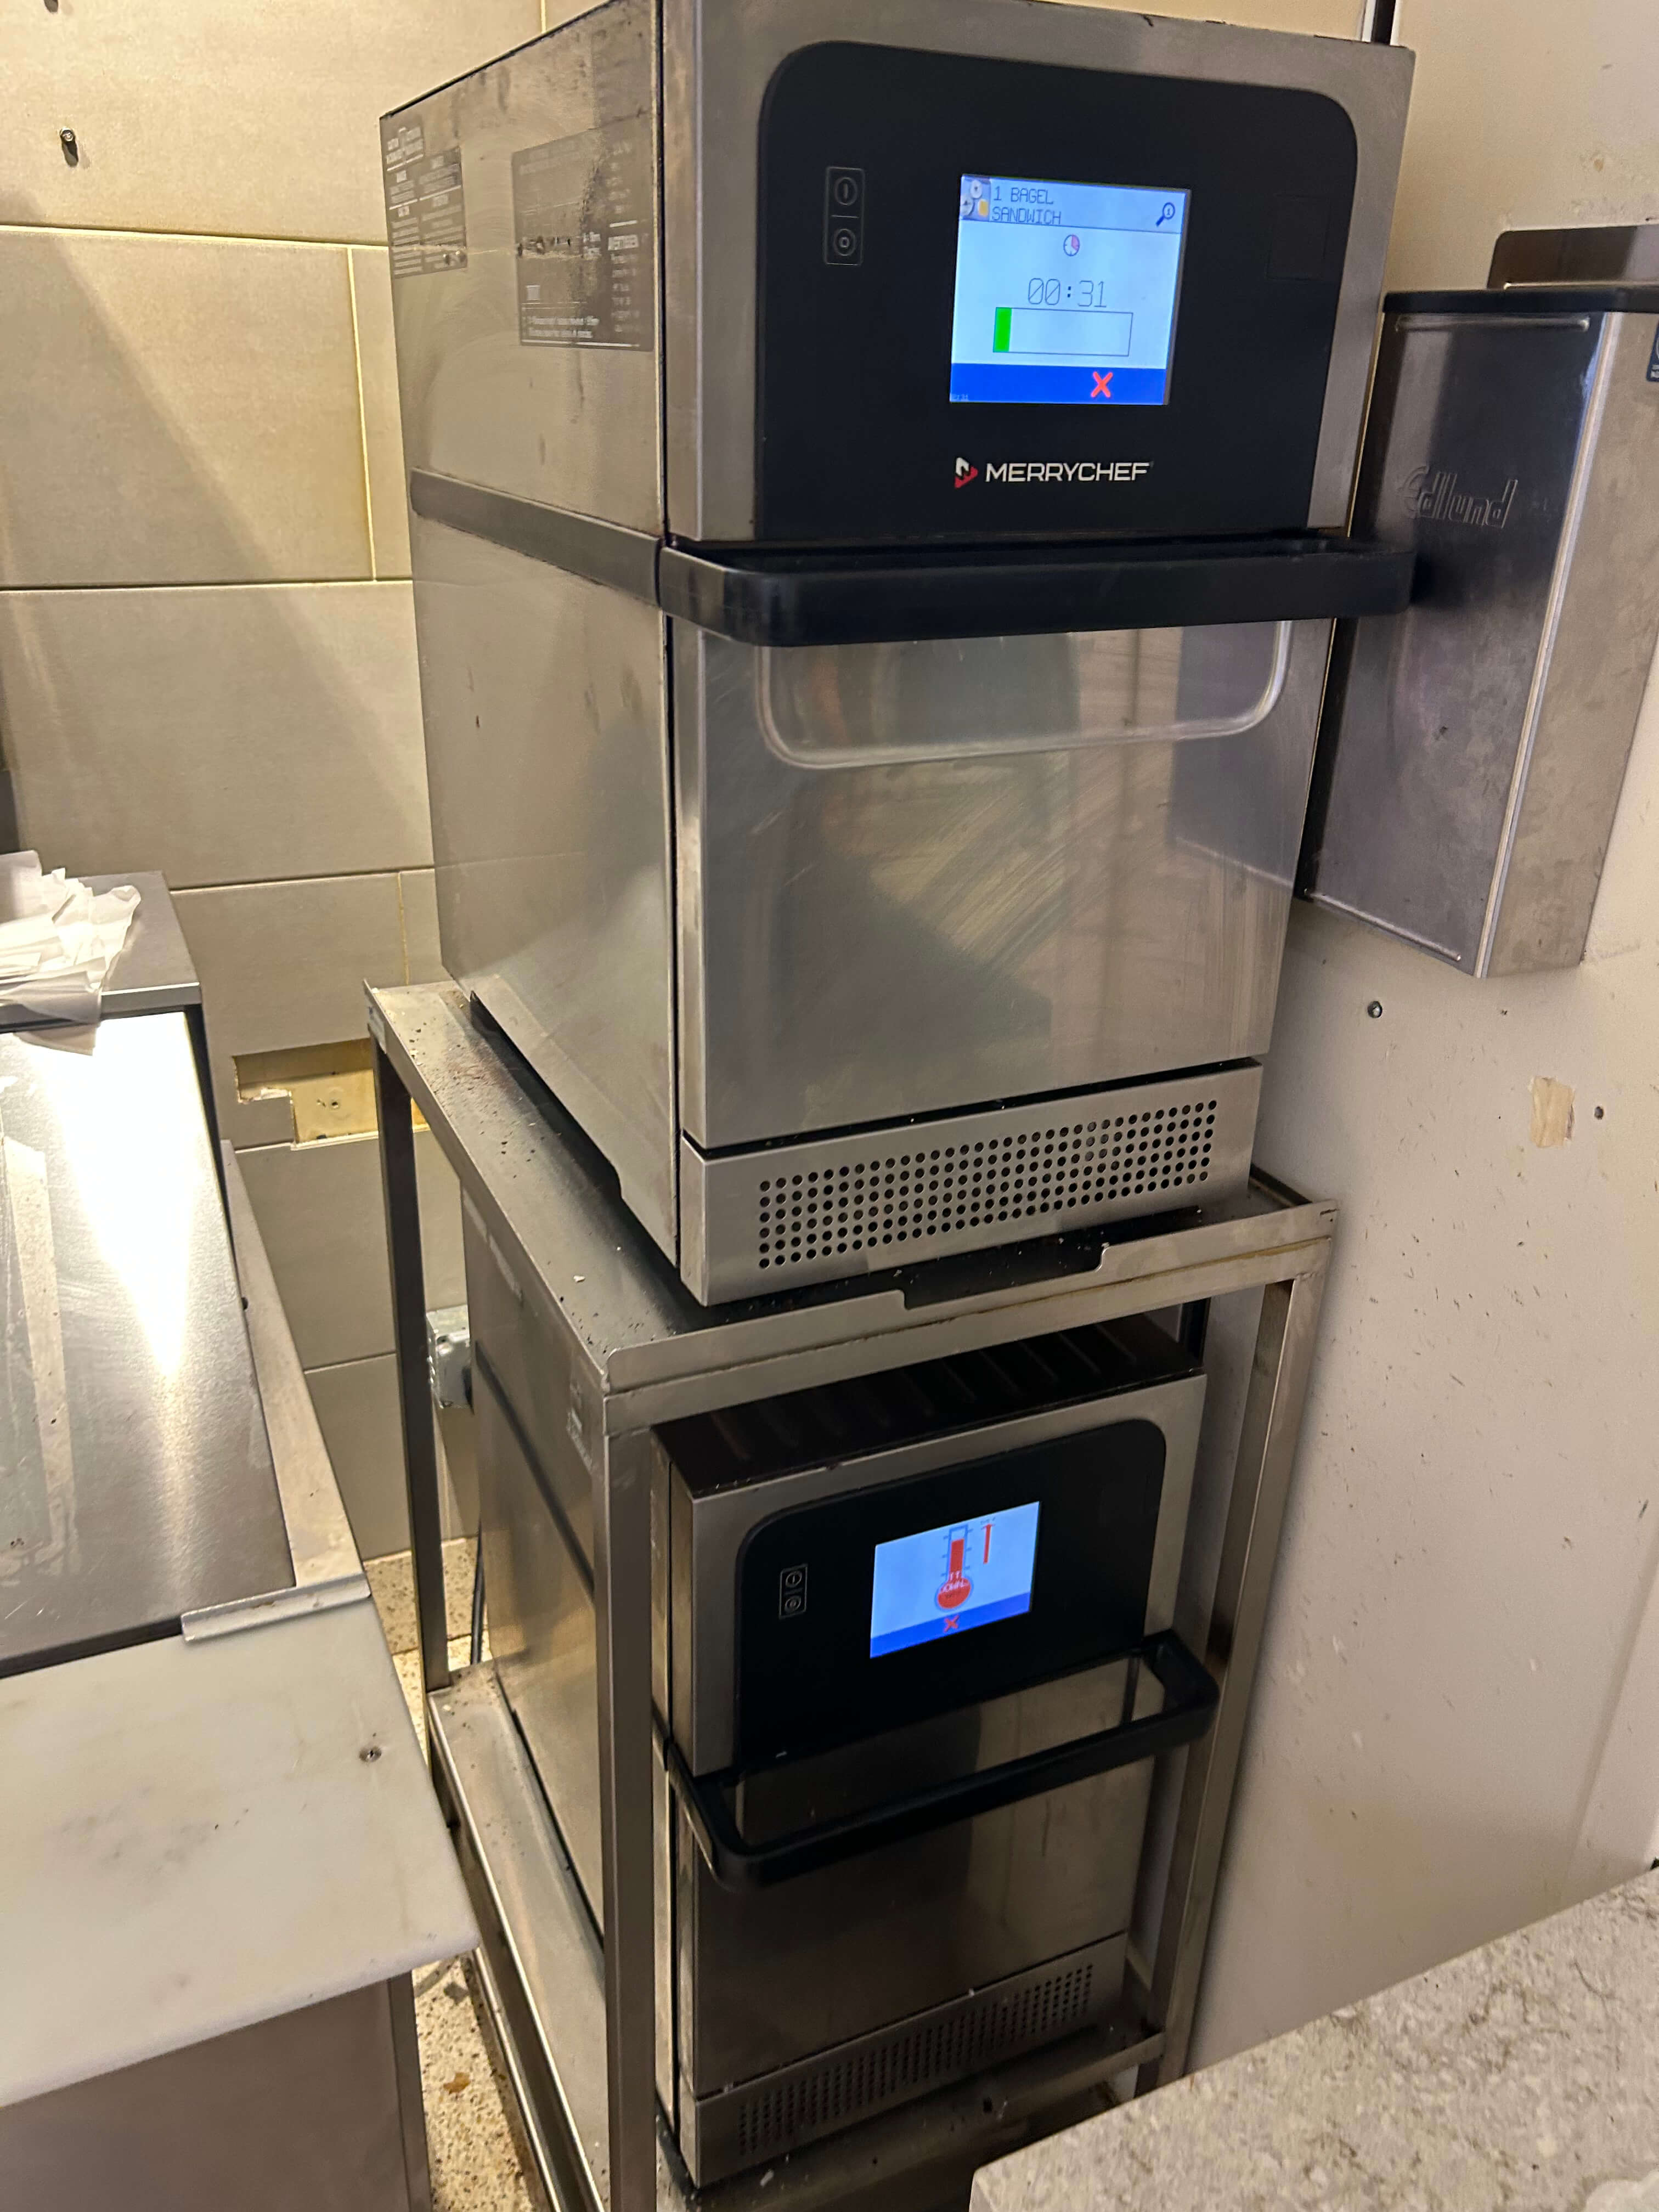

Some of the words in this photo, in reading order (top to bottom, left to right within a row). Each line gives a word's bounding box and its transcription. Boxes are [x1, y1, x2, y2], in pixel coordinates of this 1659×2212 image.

[994, 186, 1002, 201] 1
[1011, 187, 1054, 205] BAGEL
[992, 206, 1062, 224] SANDWICH
[1028, 278, 1107, 308] 00:31
[985, 462, 1150, 482] MERRYCHEF
